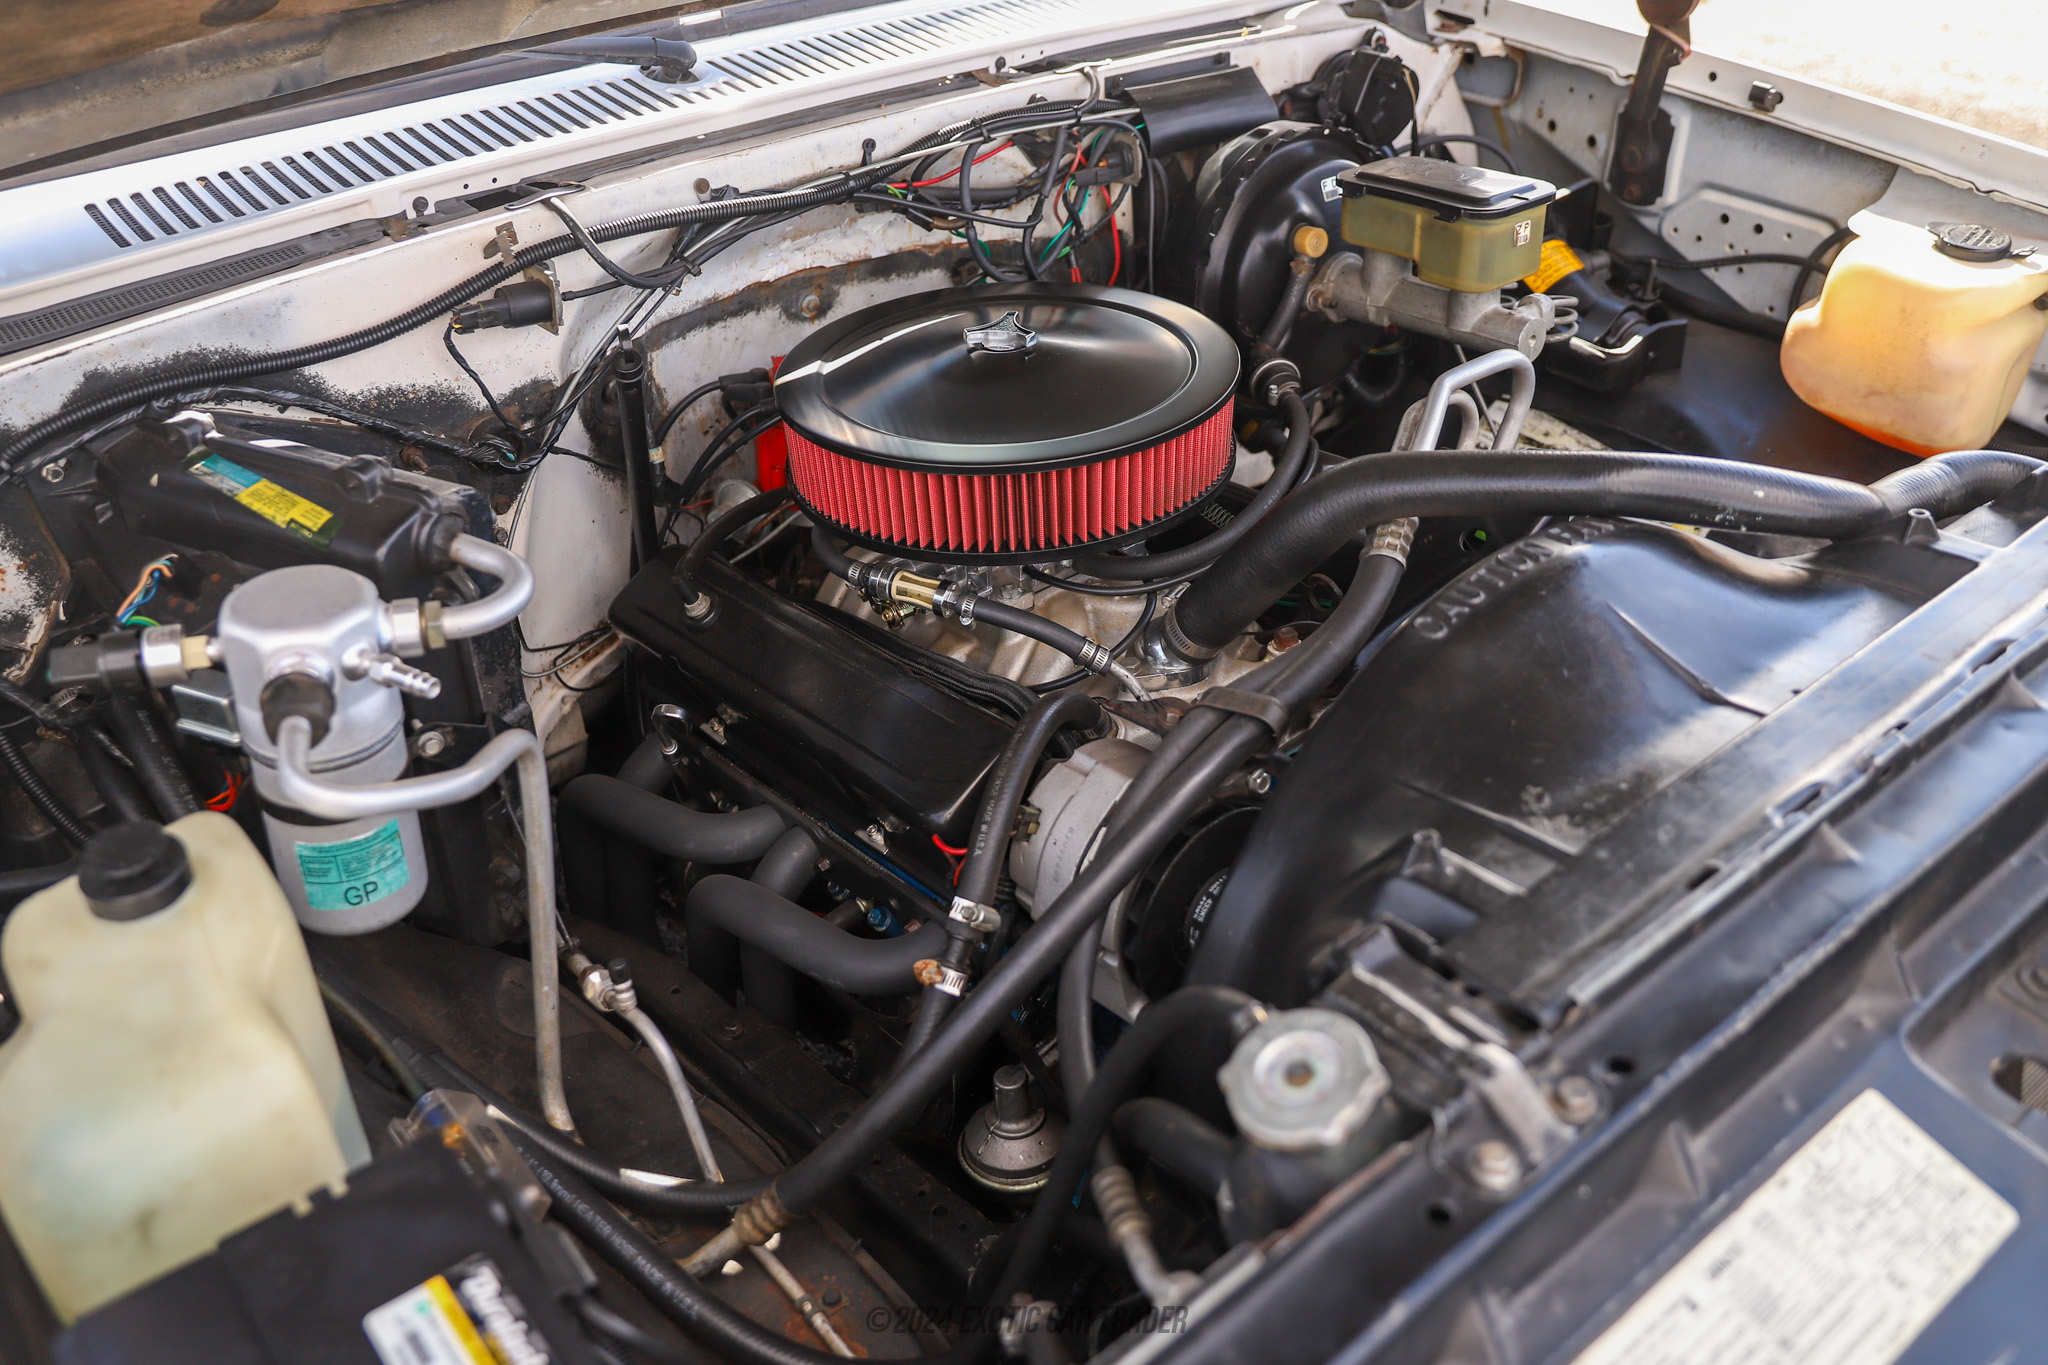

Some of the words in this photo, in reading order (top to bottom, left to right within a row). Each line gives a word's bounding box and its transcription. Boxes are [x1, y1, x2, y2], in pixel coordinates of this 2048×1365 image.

[1413, 540, 1554, 640] CAUTION
[344, 881, 378, 906] GP
[571, 1197, 613, 1238] HEATER
[608, 1231, 638, 1260] HOSE
[632, 1254, 664, 1285] MADE
